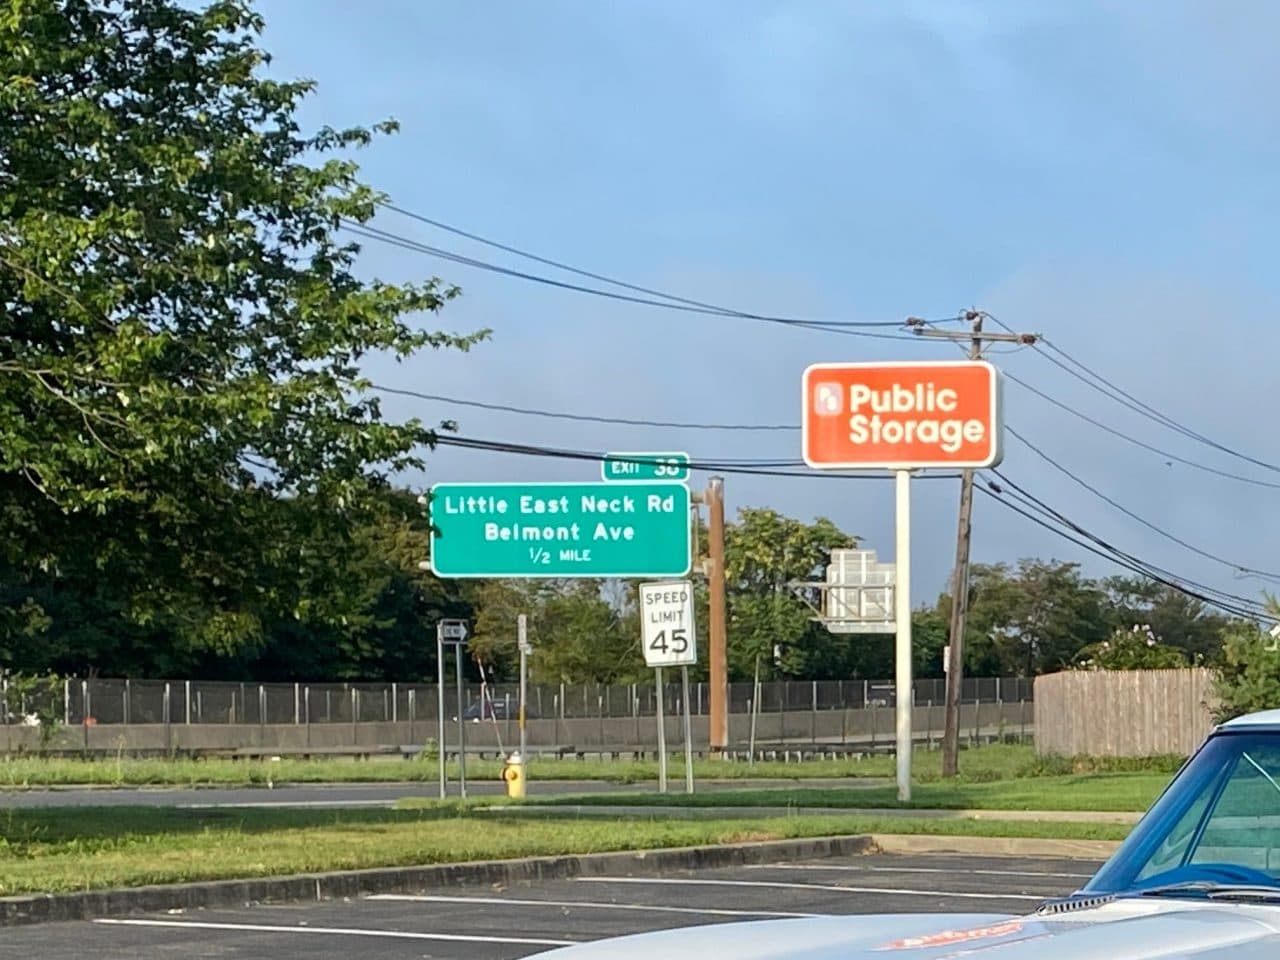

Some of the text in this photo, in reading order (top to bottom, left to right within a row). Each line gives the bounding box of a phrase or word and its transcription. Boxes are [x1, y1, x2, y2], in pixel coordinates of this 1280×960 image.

[850, 382, 958, 413] Public
[849, 414, 985, 453] Storage
[611, 460, 640, 475] EXIT
[445, 494, 674, 514] Little East Neck Rd
[485, 522, 635, 541] Belmont Ave
[560, 550, 591, 562] MILE
[646, 591, 688, 605] SPEED
[651, 610, 684, 624] LIMIT
[649, 628, 689, 655] 45
